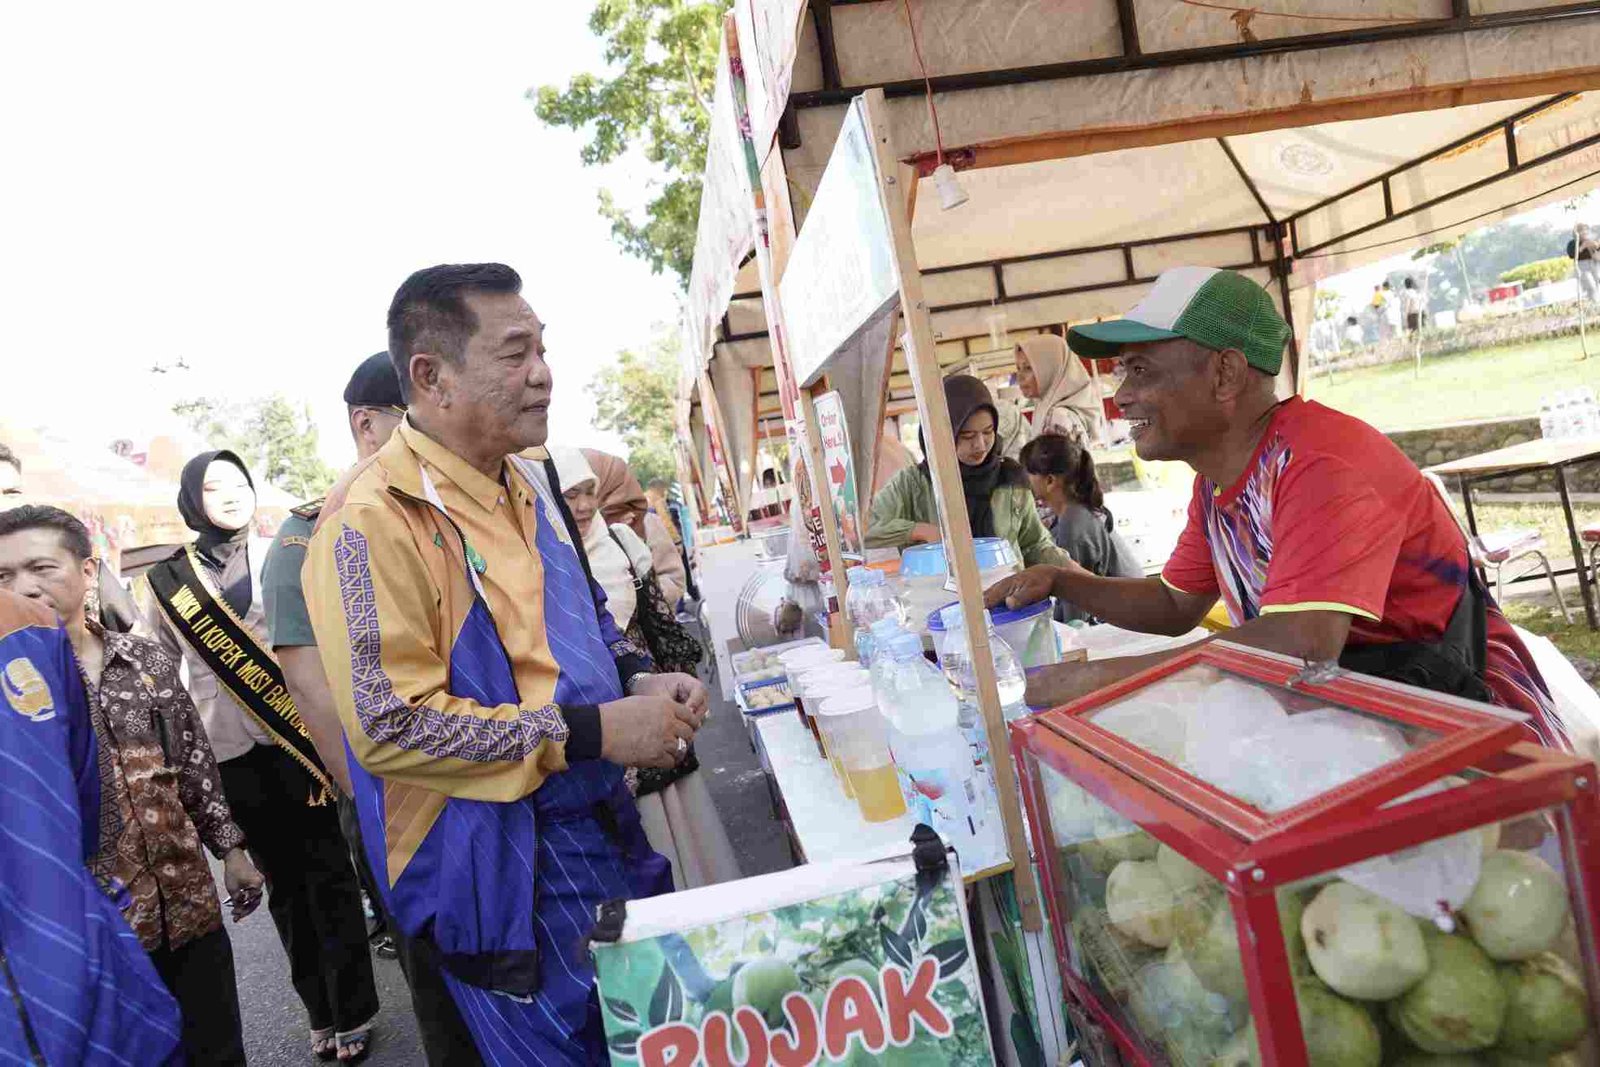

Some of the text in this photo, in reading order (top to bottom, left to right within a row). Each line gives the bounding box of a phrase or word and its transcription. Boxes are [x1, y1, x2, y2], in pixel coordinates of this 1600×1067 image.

[170, 584, 205, 624] WAKIL
[200, 624, 246, 669] KUPEK
[235, 659, 273, 694] MUSI
